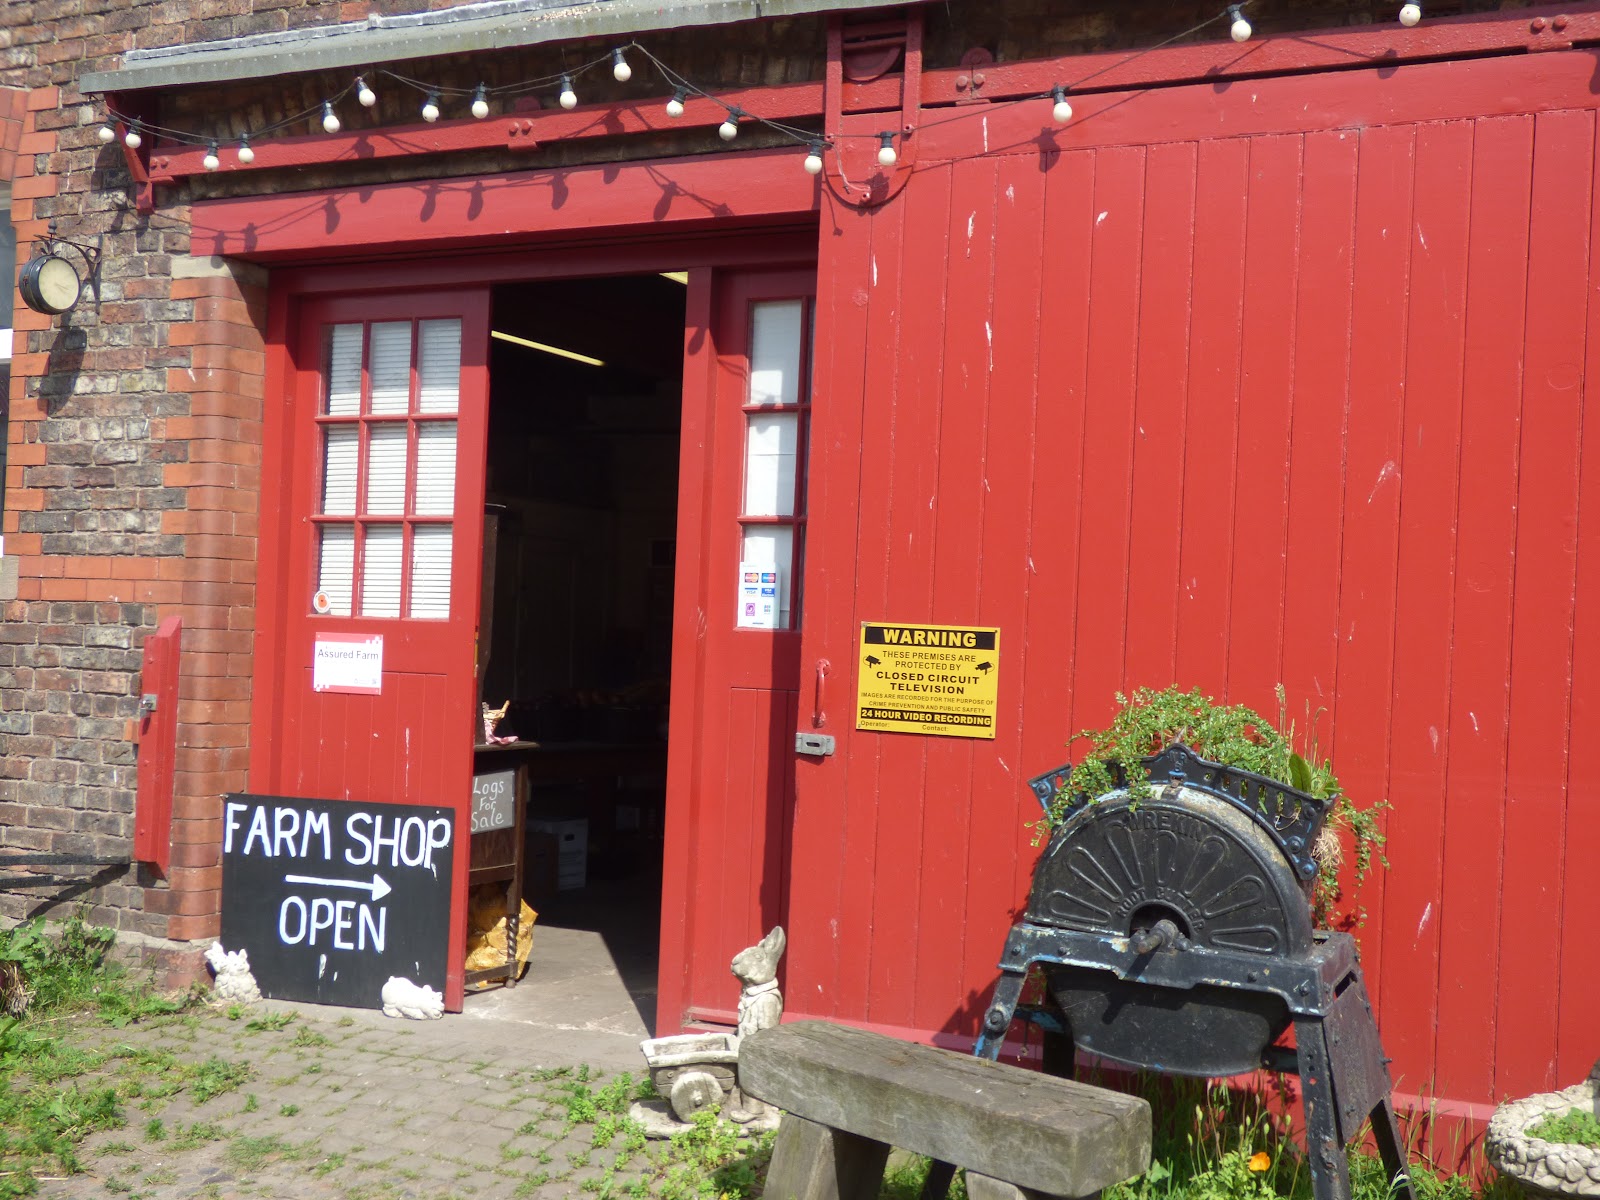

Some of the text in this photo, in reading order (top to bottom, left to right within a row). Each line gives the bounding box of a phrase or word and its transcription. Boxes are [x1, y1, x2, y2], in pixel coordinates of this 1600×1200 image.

[883, 628, 977, 648] WARNING
[317, 648, 379, 660] Assured Farm
[882, 650, 976, 663] THESE PREMISES ARE
[895, 660, 962, 671] PROTECTED BY
[876, 671, 980, 685] CLOSED CIRCUIT
[890, 682, 965, 695] TELEVISION
[896, 694, 930, 702] RECORDED
[861, 708, 991, 725] 24 HOUR VIDEO RECORDING
[962, 706, 986, 714] SAFETY
[860, 720, 949, 732] Operator: Contact:
[473, 777, 504, 800] Logs
[479, 796, 497, 811] For
[471, 808, 504, 832] Sale
[224, 802, 451, 869] FARM SHOP
[1115, 886, 1206, 931] ROOT CUTTER
[279, 895, 387, 953] OPEN
